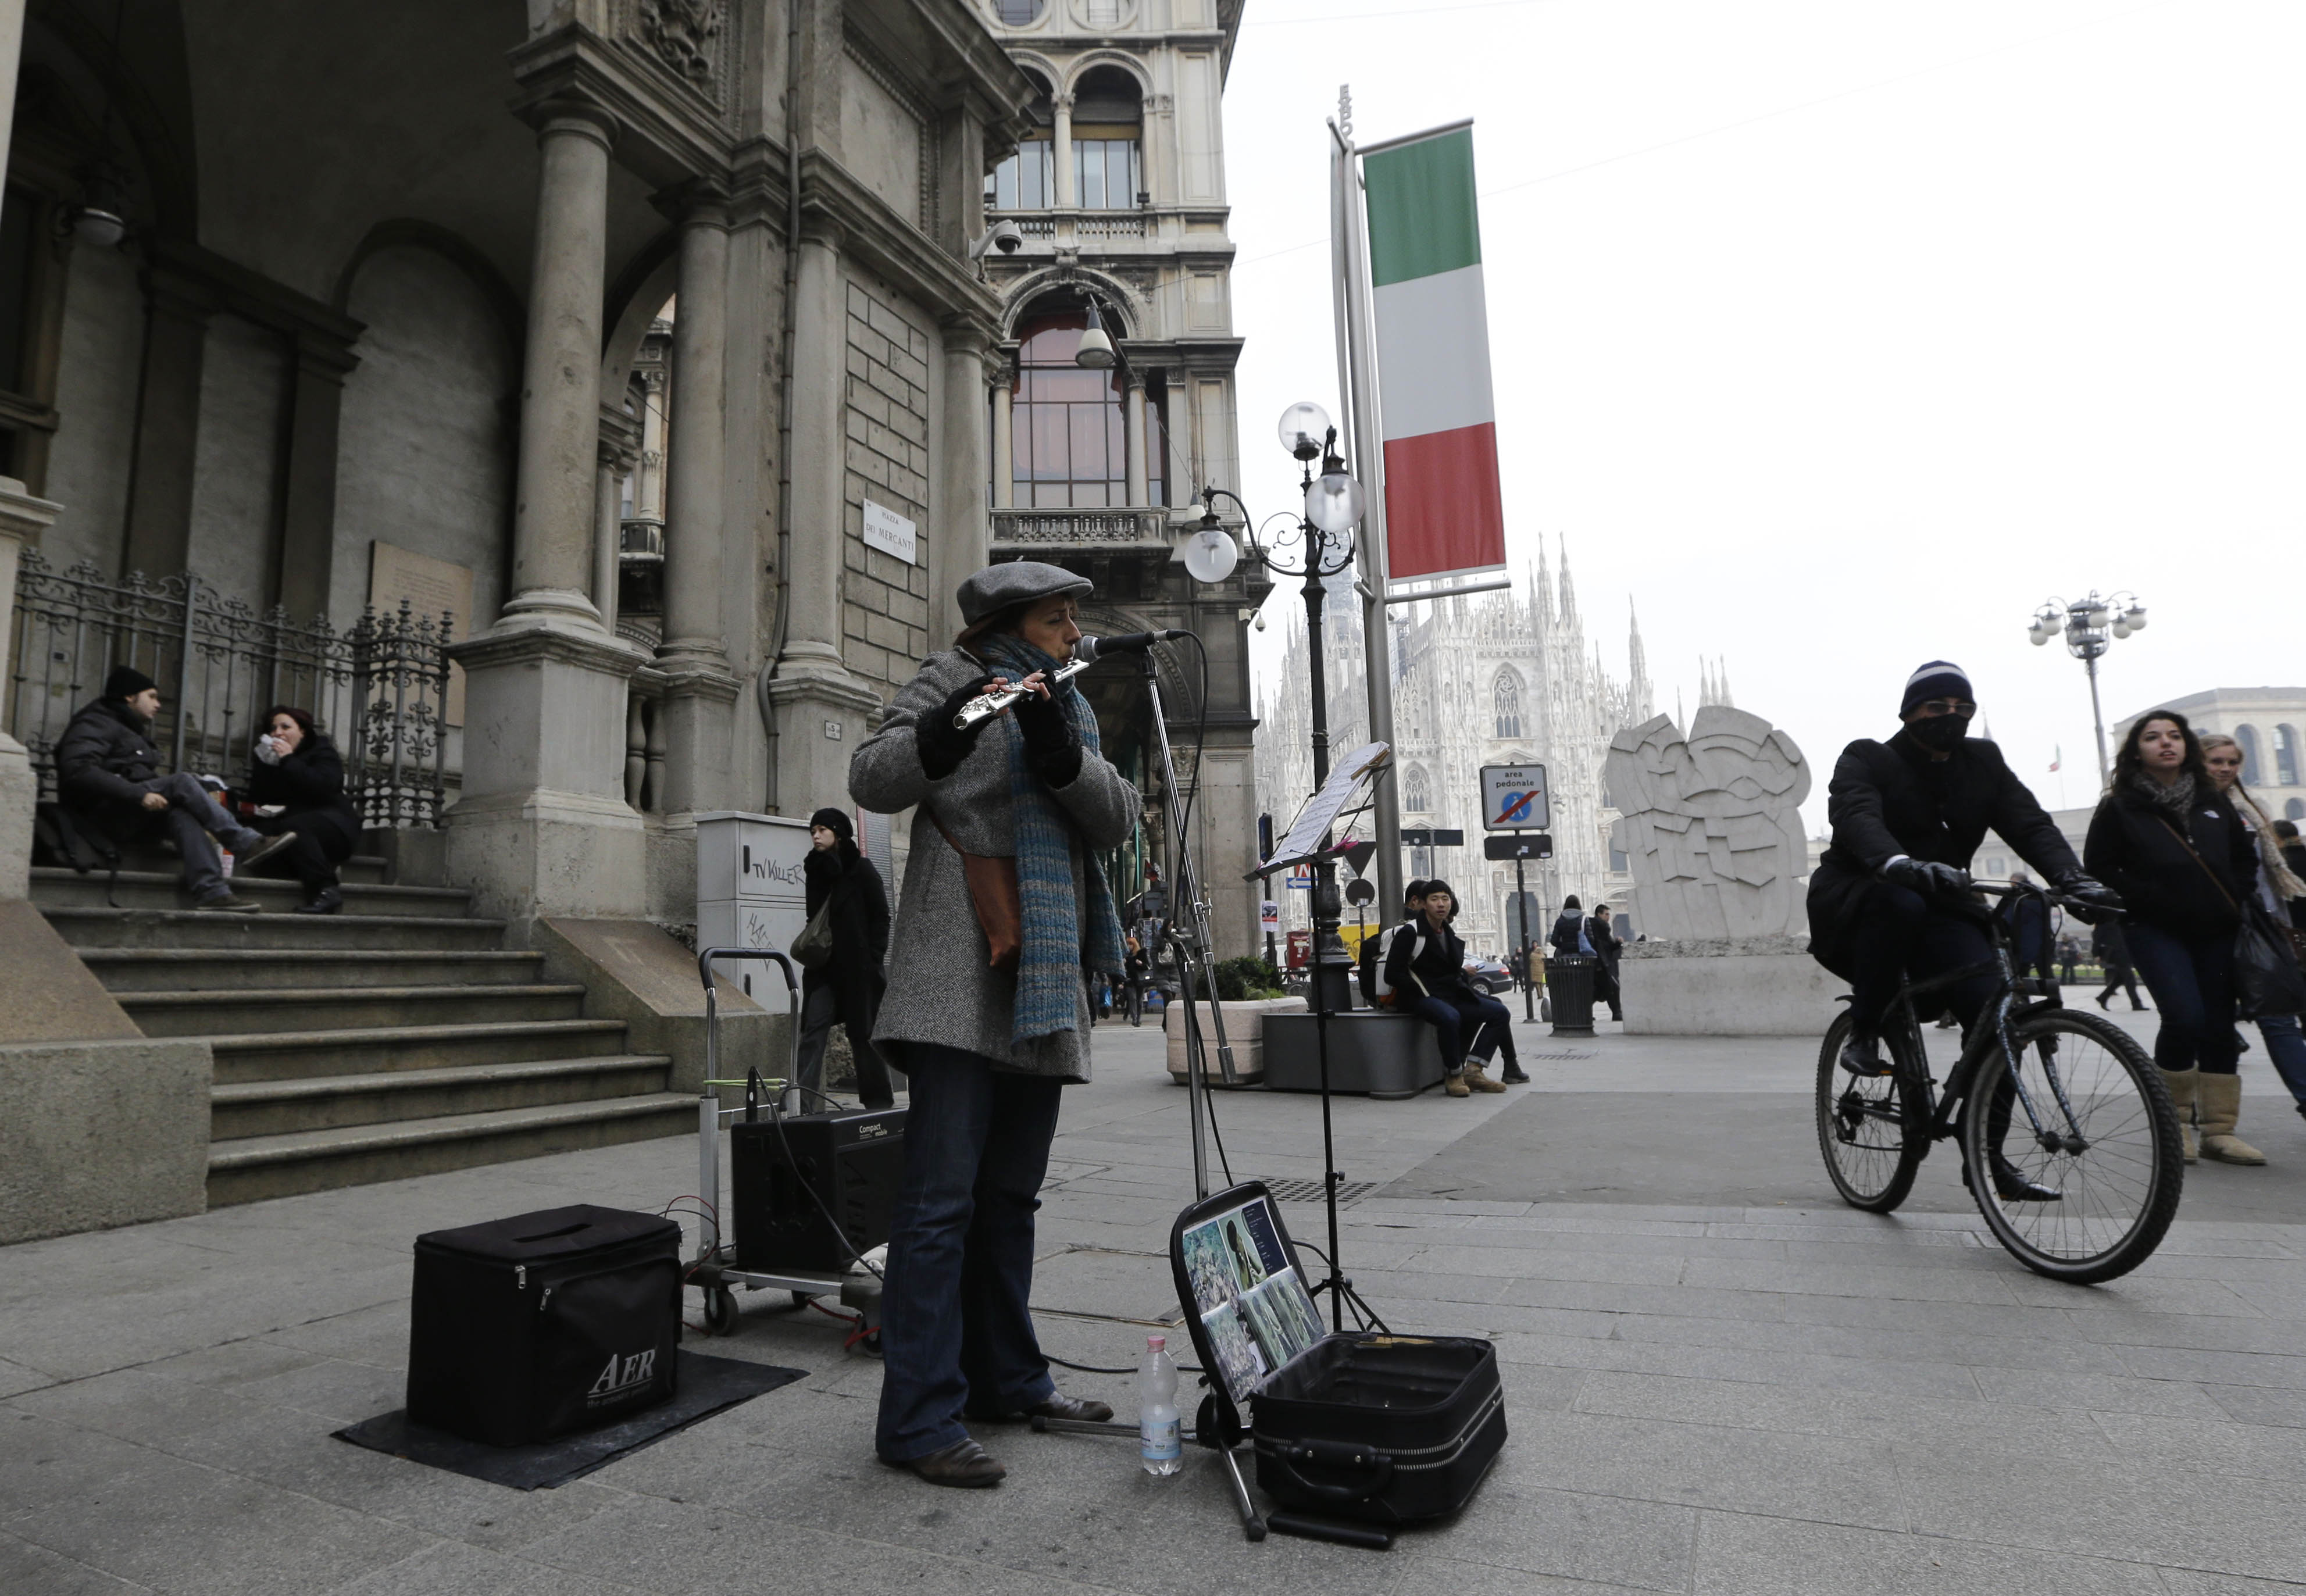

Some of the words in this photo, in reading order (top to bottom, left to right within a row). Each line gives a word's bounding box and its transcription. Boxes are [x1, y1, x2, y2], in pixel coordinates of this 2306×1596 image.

[882, 512, 898, 524] PIAZZA
[866, 523, 874, 533] DEI
[879, 527, 913, 551] MERCANTI
[1496, 780, 1534, 788] pedonale
[768, 859, 805, 884] KILLER
[859, 1123, 881, 1133] Compact
[588, 1349, 655, 1394] AER
